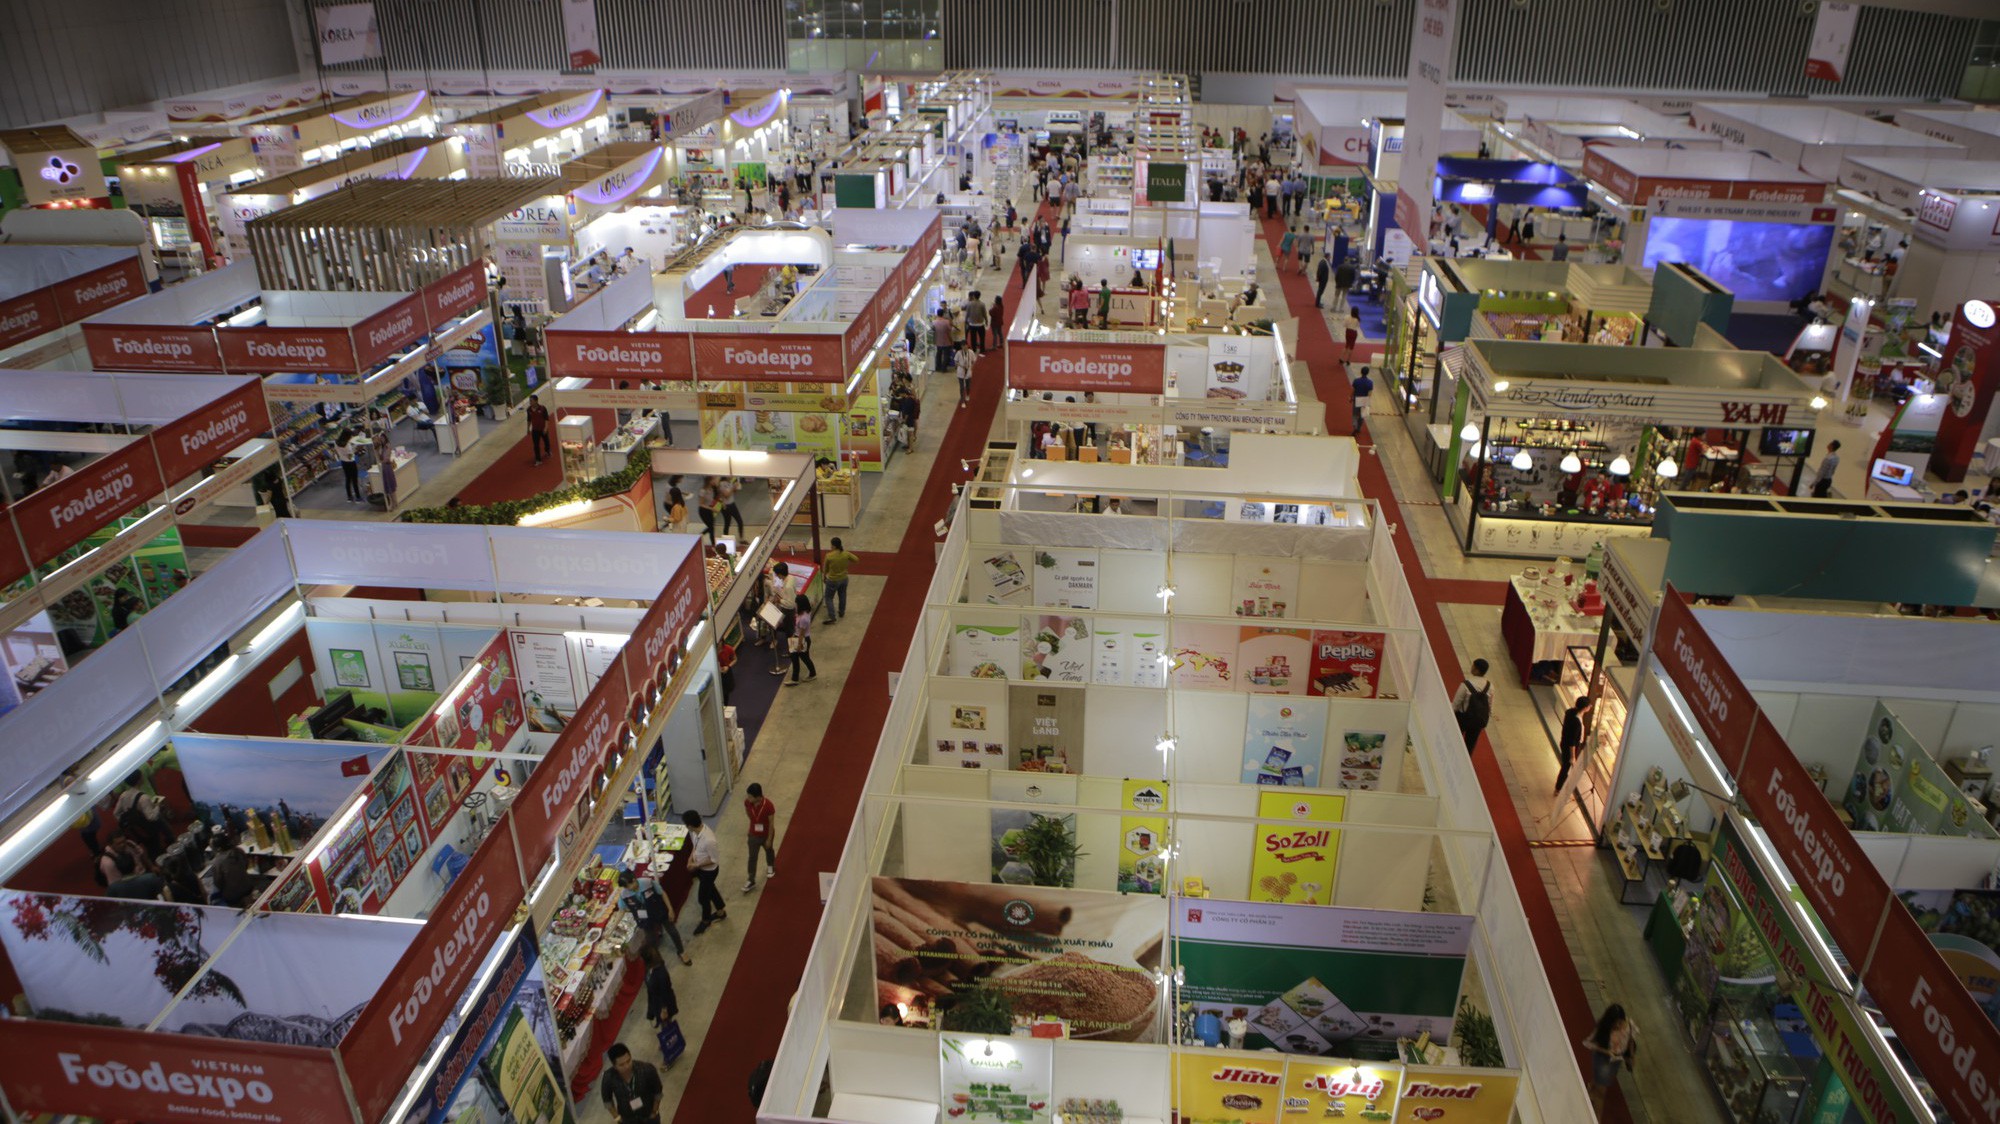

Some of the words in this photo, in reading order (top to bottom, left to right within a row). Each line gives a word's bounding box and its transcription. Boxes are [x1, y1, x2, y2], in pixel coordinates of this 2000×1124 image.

[320, 28, 355, 44] KOREA
[1710, 122, 1745, 145] MALAYSIA
[194, 156, 224, 176] OREA
[599, 172, 627, 198] KOREA
[1151, 177, 1182, 187] ITALIA
[1654, 184, 1710, 199] Foodexpo
[1749, 189, 1805, 202] Foodexpo
[502, 207, 558, 221] KOREA
[75, 276, 128, 304] Foodexpo
[437, 280, 475, 309] Foodexpo
[369, 315, 413, 348] Foodexpo
[112, 337, 192, 358] Foodexpo
[247, 340, 326, 361] Foodexpo
[576, 345, 662, 365] Foodexpo
[725, 347, 813, 369] Foodexpo
[1039, 355, 1132, 379] Foodexpo
[1175, 411, 1189, 420] CÔNG
[1197, 413, 1210, 421] TNHH
[1242, 416, 1263, 424] MEKONG
[1721, 402, 1788, 425] YAMI
[180, 409, 247, 455] Foodexpo
[101, 462, 129, 481] VIETNAM
[50, 473, 134, 530] Foodexpo
[1068, 581, 1093, 589] DAKMARK
[644, 586, 692, 667] Foodexpo
[1320, 643, 1376, 661] PepPie
[1674, 627, 1729, 722] Foodexpo
[1032, 726, 1060, 736] LAND
[1034, 716, 1058, 727] VIỆT
[542, 712, 609, 820] Foodexpo
[1265, 830, 1330, 852] SoZoll
[1767, 766, 1845, 898] Foodexpo
[1822, 829, 1851, 873] VIETNAM
[451, 874, 485, 922] VIETNAM
[926, 928, 951, 937] CÔNG
[952, 929, 963, 937] TY
[1723, 840, 1757, 909] TRUNG
[1755, 906, 1782, 945] TÂM
[1806, 981, 1841, 1043] TIẾN
[980, 954, 1029, 964] MANUFACTURING
[1040, 945, 1064, 954] NAM
[388, 891, 491, 1047] Foodexpo
[1068, 1019, 1085, 1028] TAR
[1086, 1019, 1132, 1030] ANISEED
[190, 1058, 265, 1075] VIETNAM
[1213, 1066, 1282, 1087] Hữu
[57, 1052, 273, 1107] Foodexpo
[1303, 1072, 1385, 1101] Nghị
[1402, 1082, 1483, 1101] Food
[167, 1103, 198, 1115] Better
[200, 1106, 230, 1119] food,
[230, 1108, 263, 1120] better
[264, 1111, 282, 1122] life
